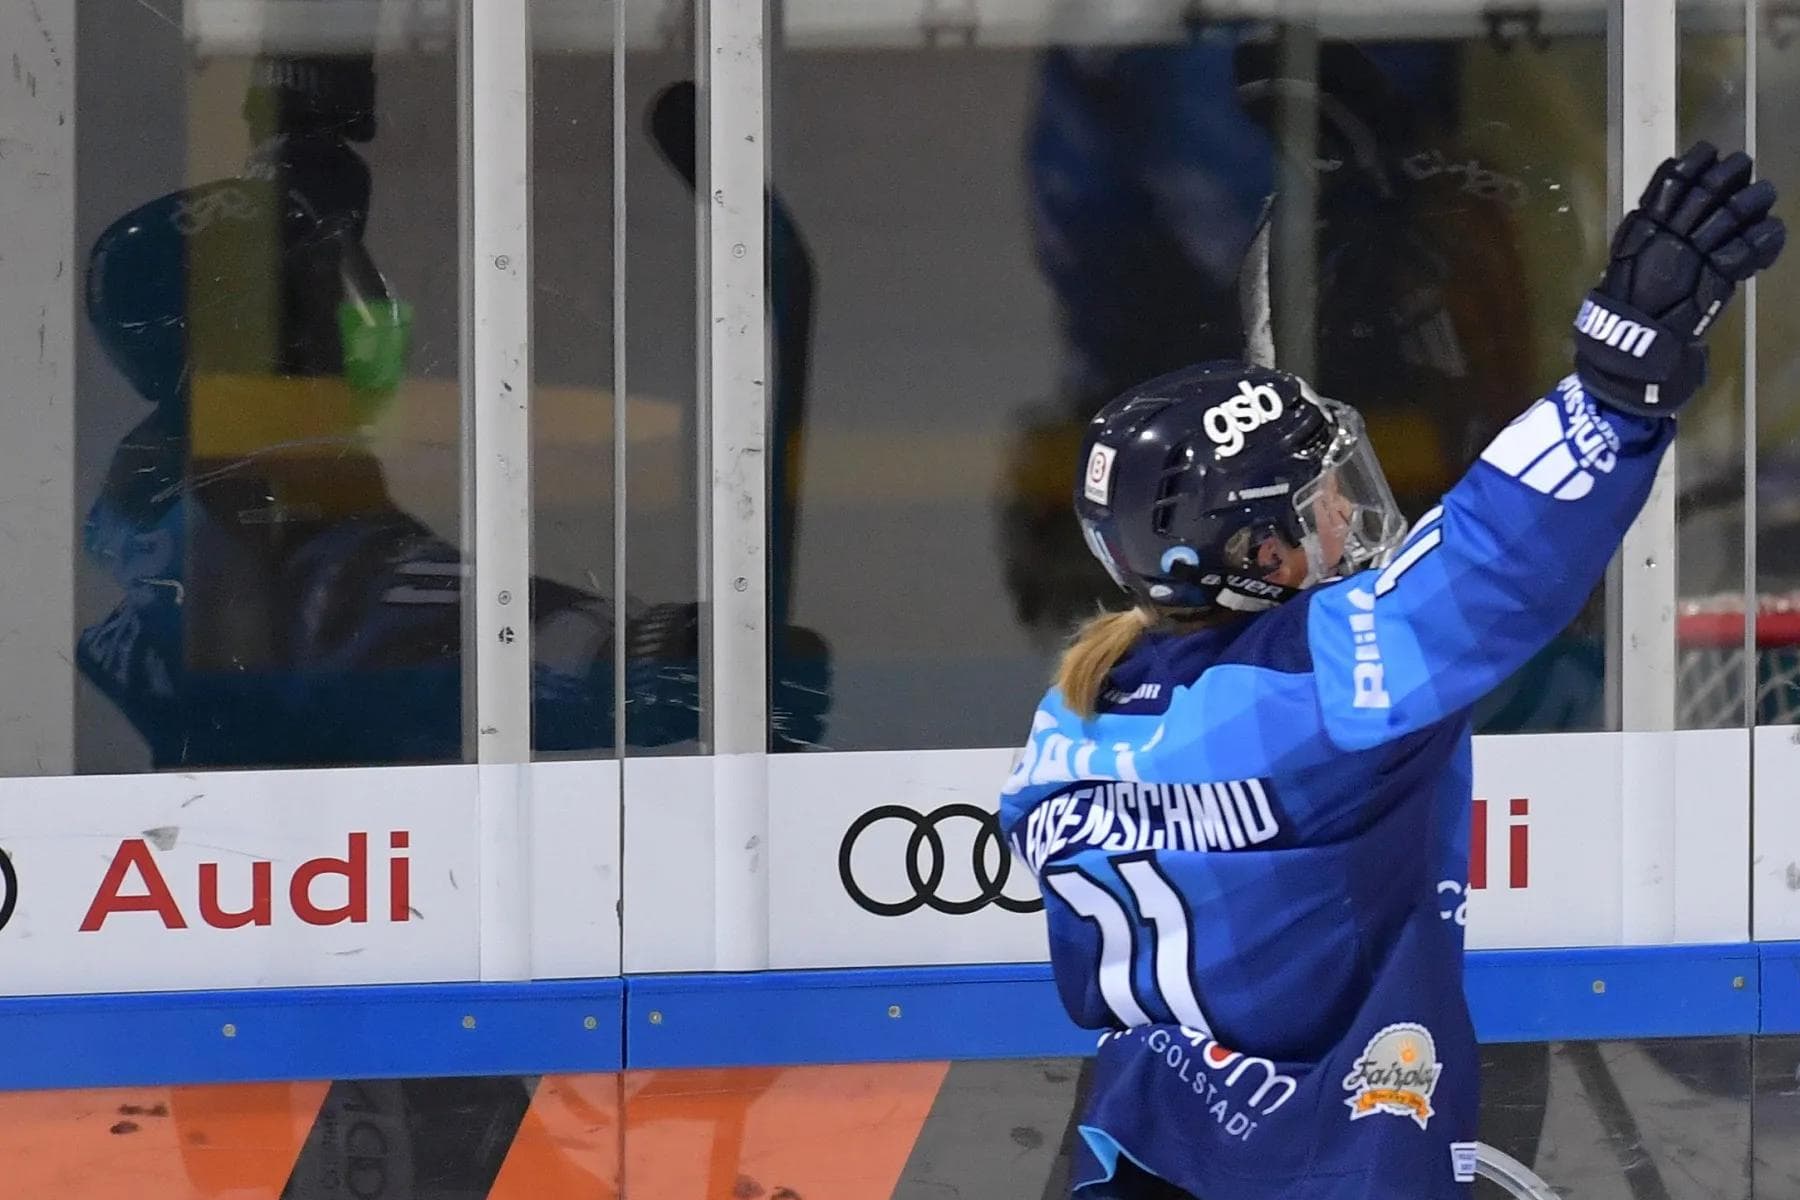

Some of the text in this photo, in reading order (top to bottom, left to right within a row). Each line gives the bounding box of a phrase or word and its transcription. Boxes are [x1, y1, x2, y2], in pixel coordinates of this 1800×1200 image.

[1203, 380, 1283, 458] gsb
[79, 830, 411, 932] Audi
[1047, 860, 1214, 1040] 11
[1140, 1030, 1259, 1142] GOLSTADT
